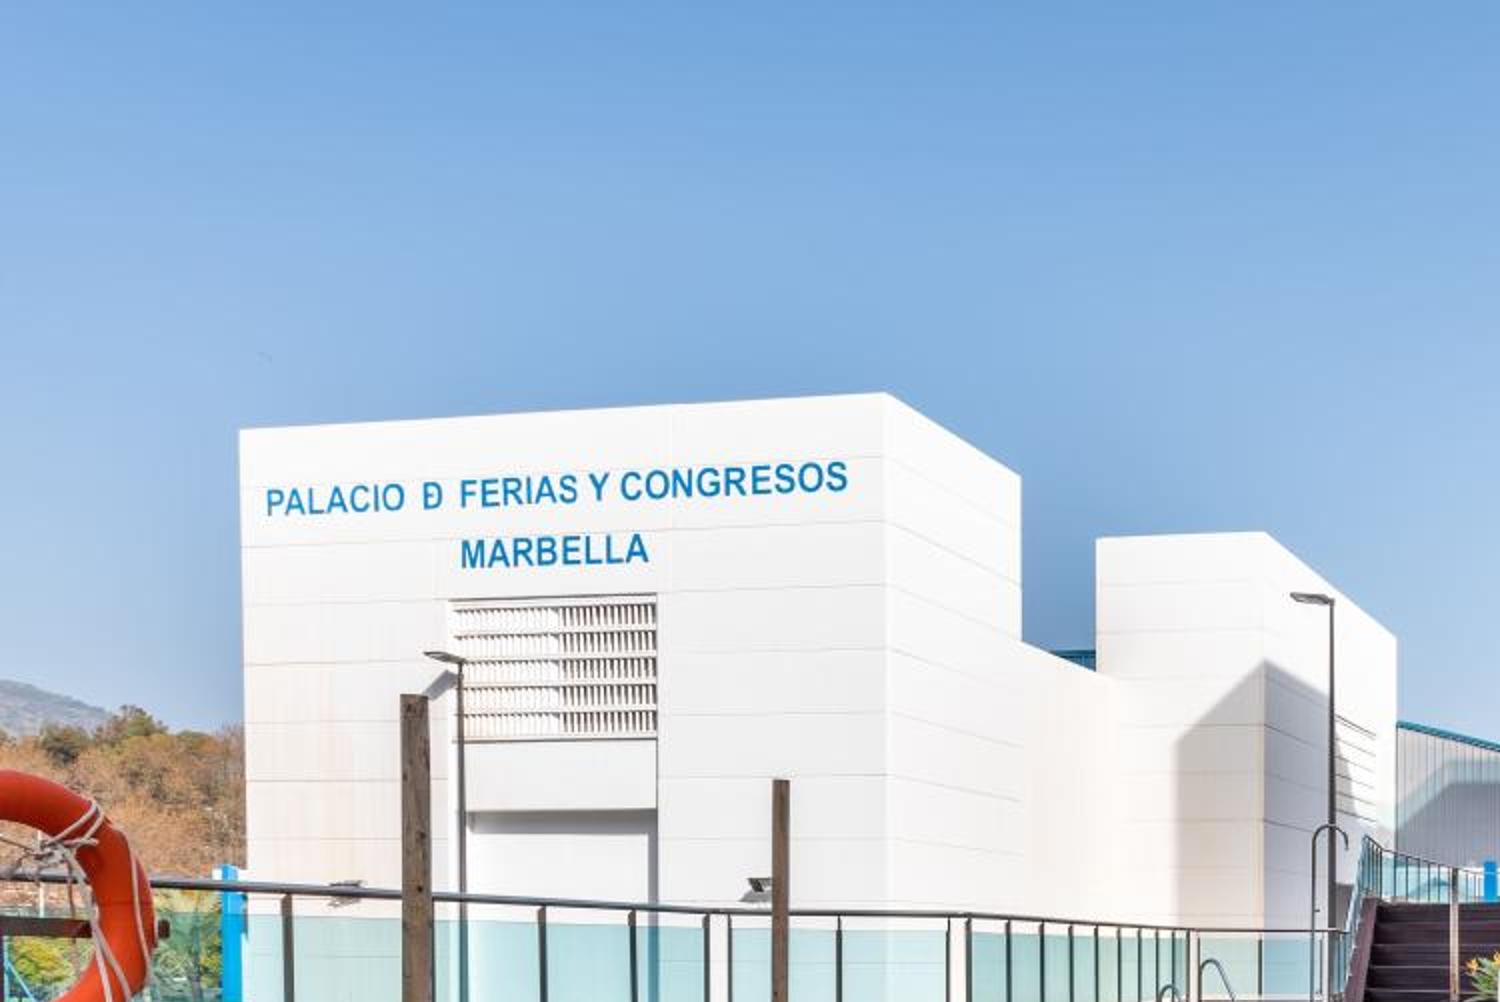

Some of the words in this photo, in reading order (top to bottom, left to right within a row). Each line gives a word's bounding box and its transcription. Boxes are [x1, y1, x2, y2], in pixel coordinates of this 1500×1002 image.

[266, 482, 406, 516] PALACIO
[459, 474, 579, 510] FERIAS
[588, 473, 610, 502] Y
[620, 460, 850, 502] CONGRESOS
[460, 532, 650, 570] MARBELLA
